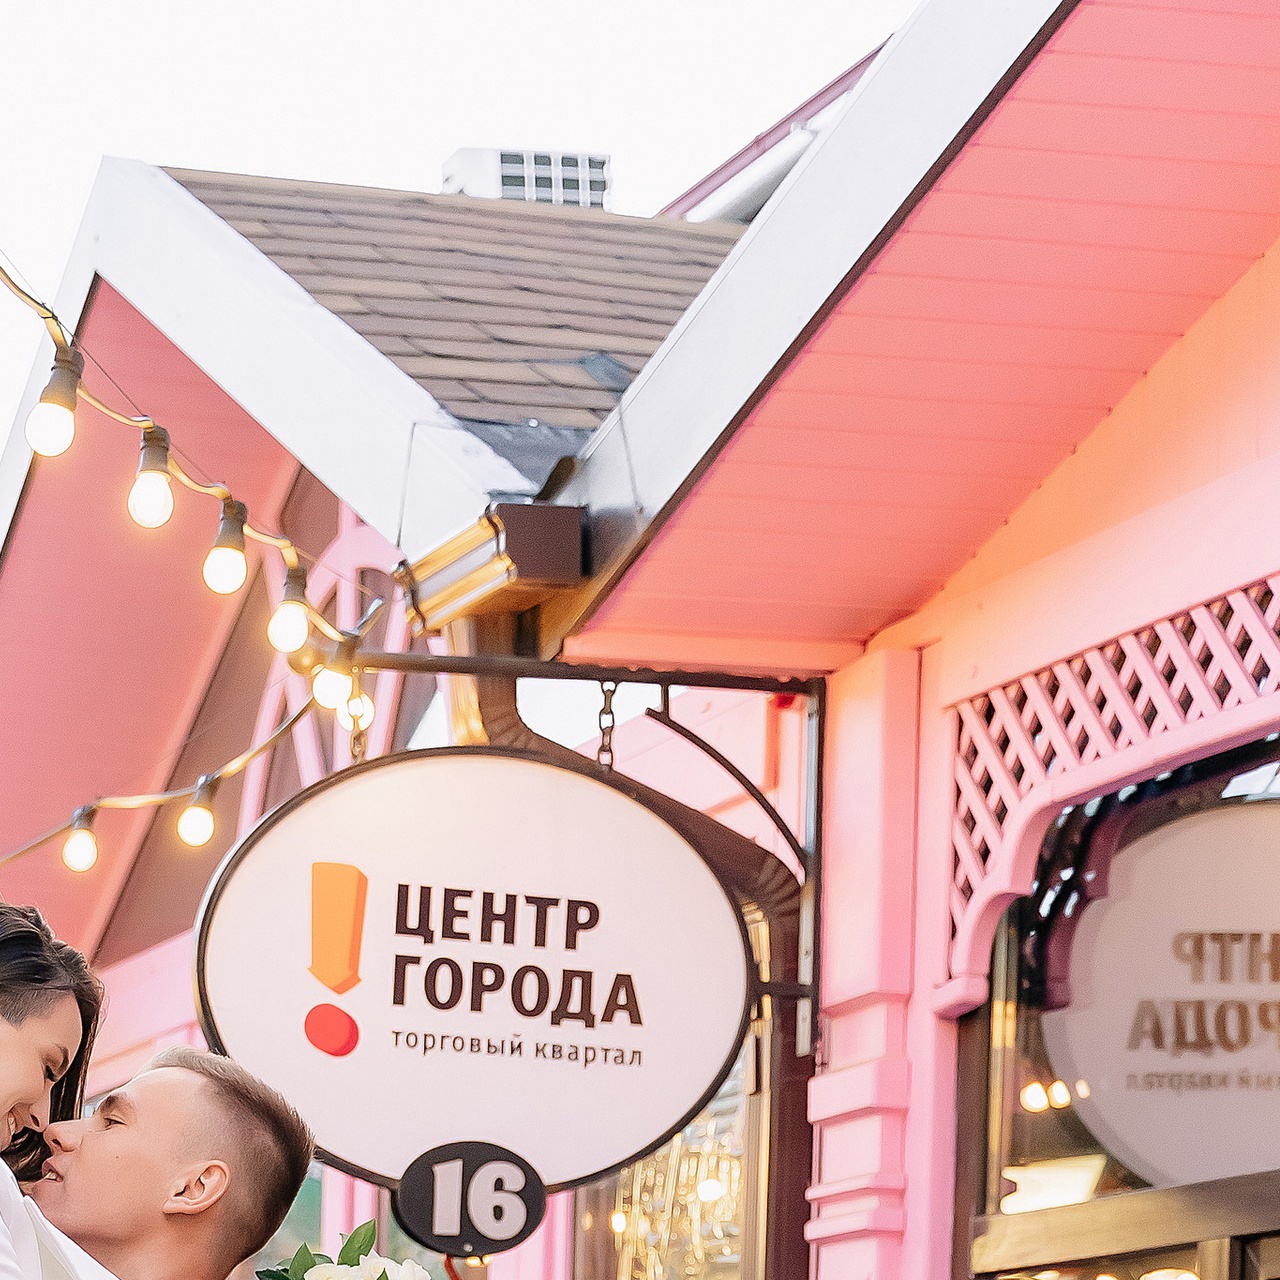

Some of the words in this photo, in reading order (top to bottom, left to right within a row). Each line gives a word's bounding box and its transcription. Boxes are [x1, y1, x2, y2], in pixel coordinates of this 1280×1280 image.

[395, 883, 600, 951] ЦЕНТР
[392, 954, 642, 1028] ГОРОДА
[392, 1030, 523, 1057] торговый
[535, 1042, 642, 1068] квартал
[433, 1159, 527, 1240] 16
